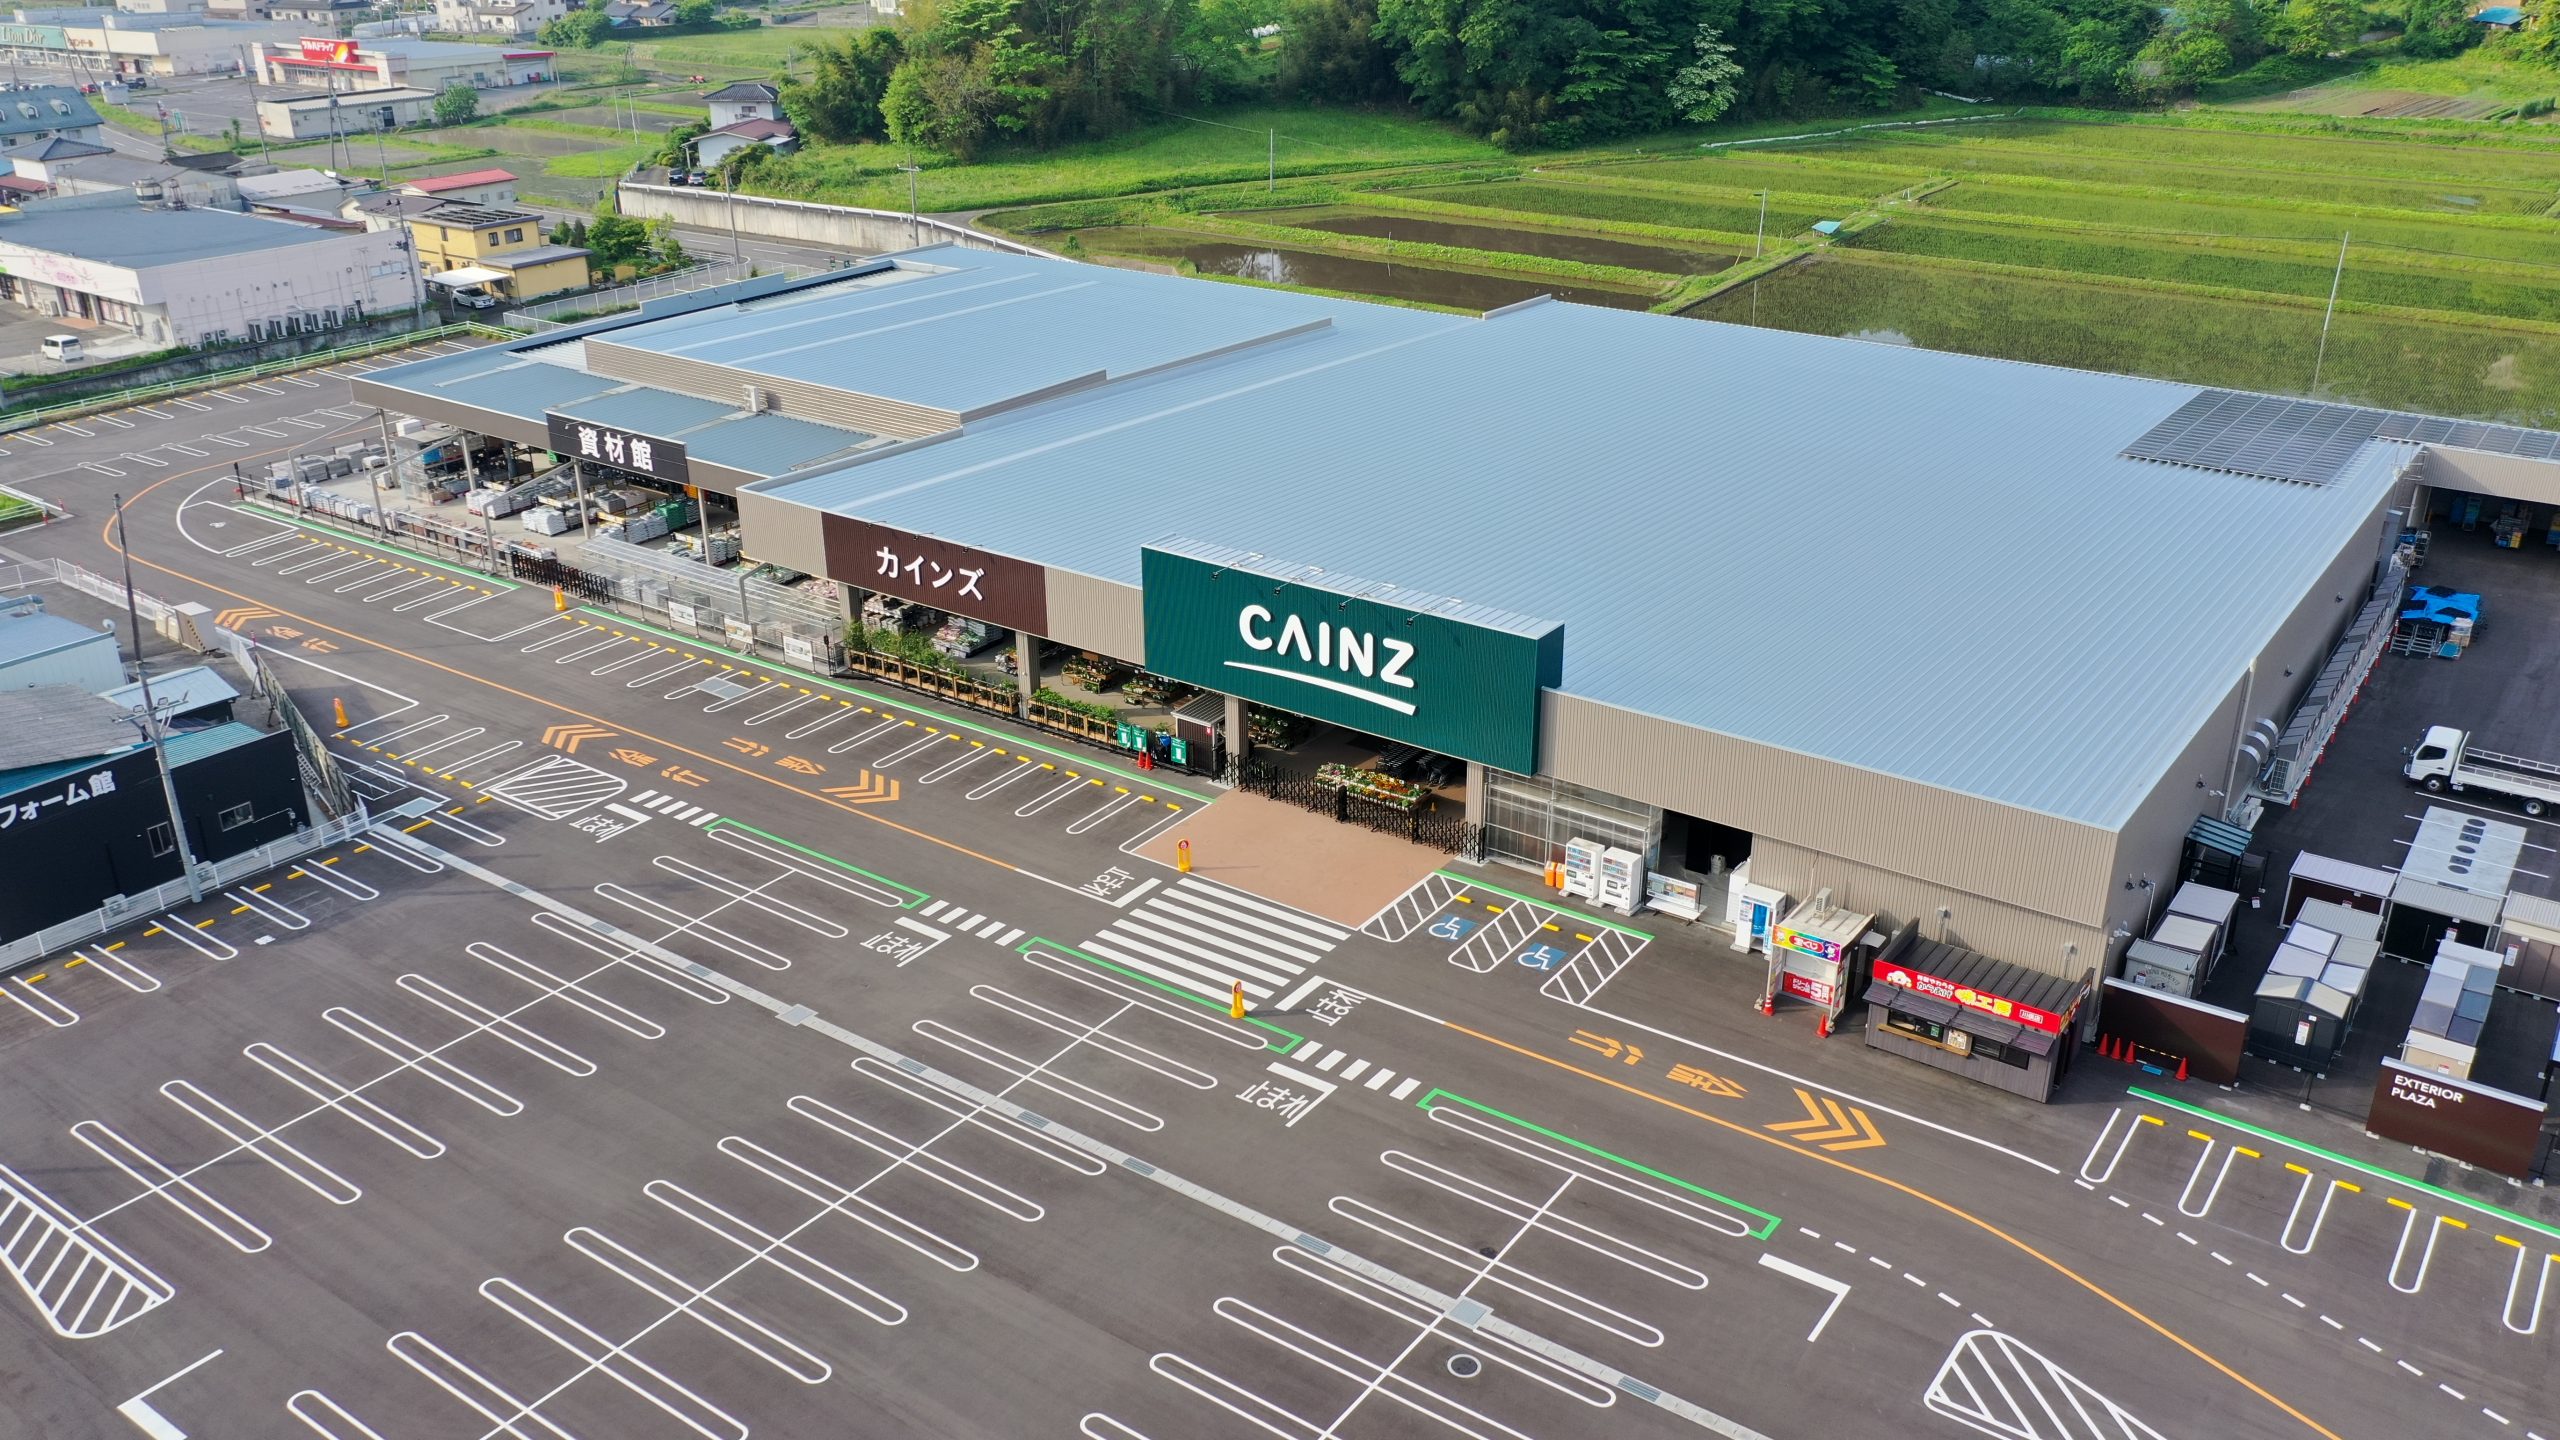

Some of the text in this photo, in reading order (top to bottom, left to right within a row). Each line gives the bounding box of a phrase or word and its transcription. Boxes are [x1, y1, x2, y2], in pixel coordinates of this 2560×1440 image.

[2, 25, 24, 43] Lion
[577, 425, 655, 472] 資材館
[876, 546, 985, 602] カインズ
[1239, 604, 1415, 688] CAINZ
[568, 814, 624, 838] 止まれ
[1079, 866, 1135, 896] 止まれ
[860, 931, 923, 961] 止まれ
[1305, 989, 1367, 1027] 止まれ
[1235, 1080, 1309, 1119] 止まれ
[2391, 1087, 2436, 1109] PLAZA
[2394, 1074, 2464, 1103] EXTERIOR
